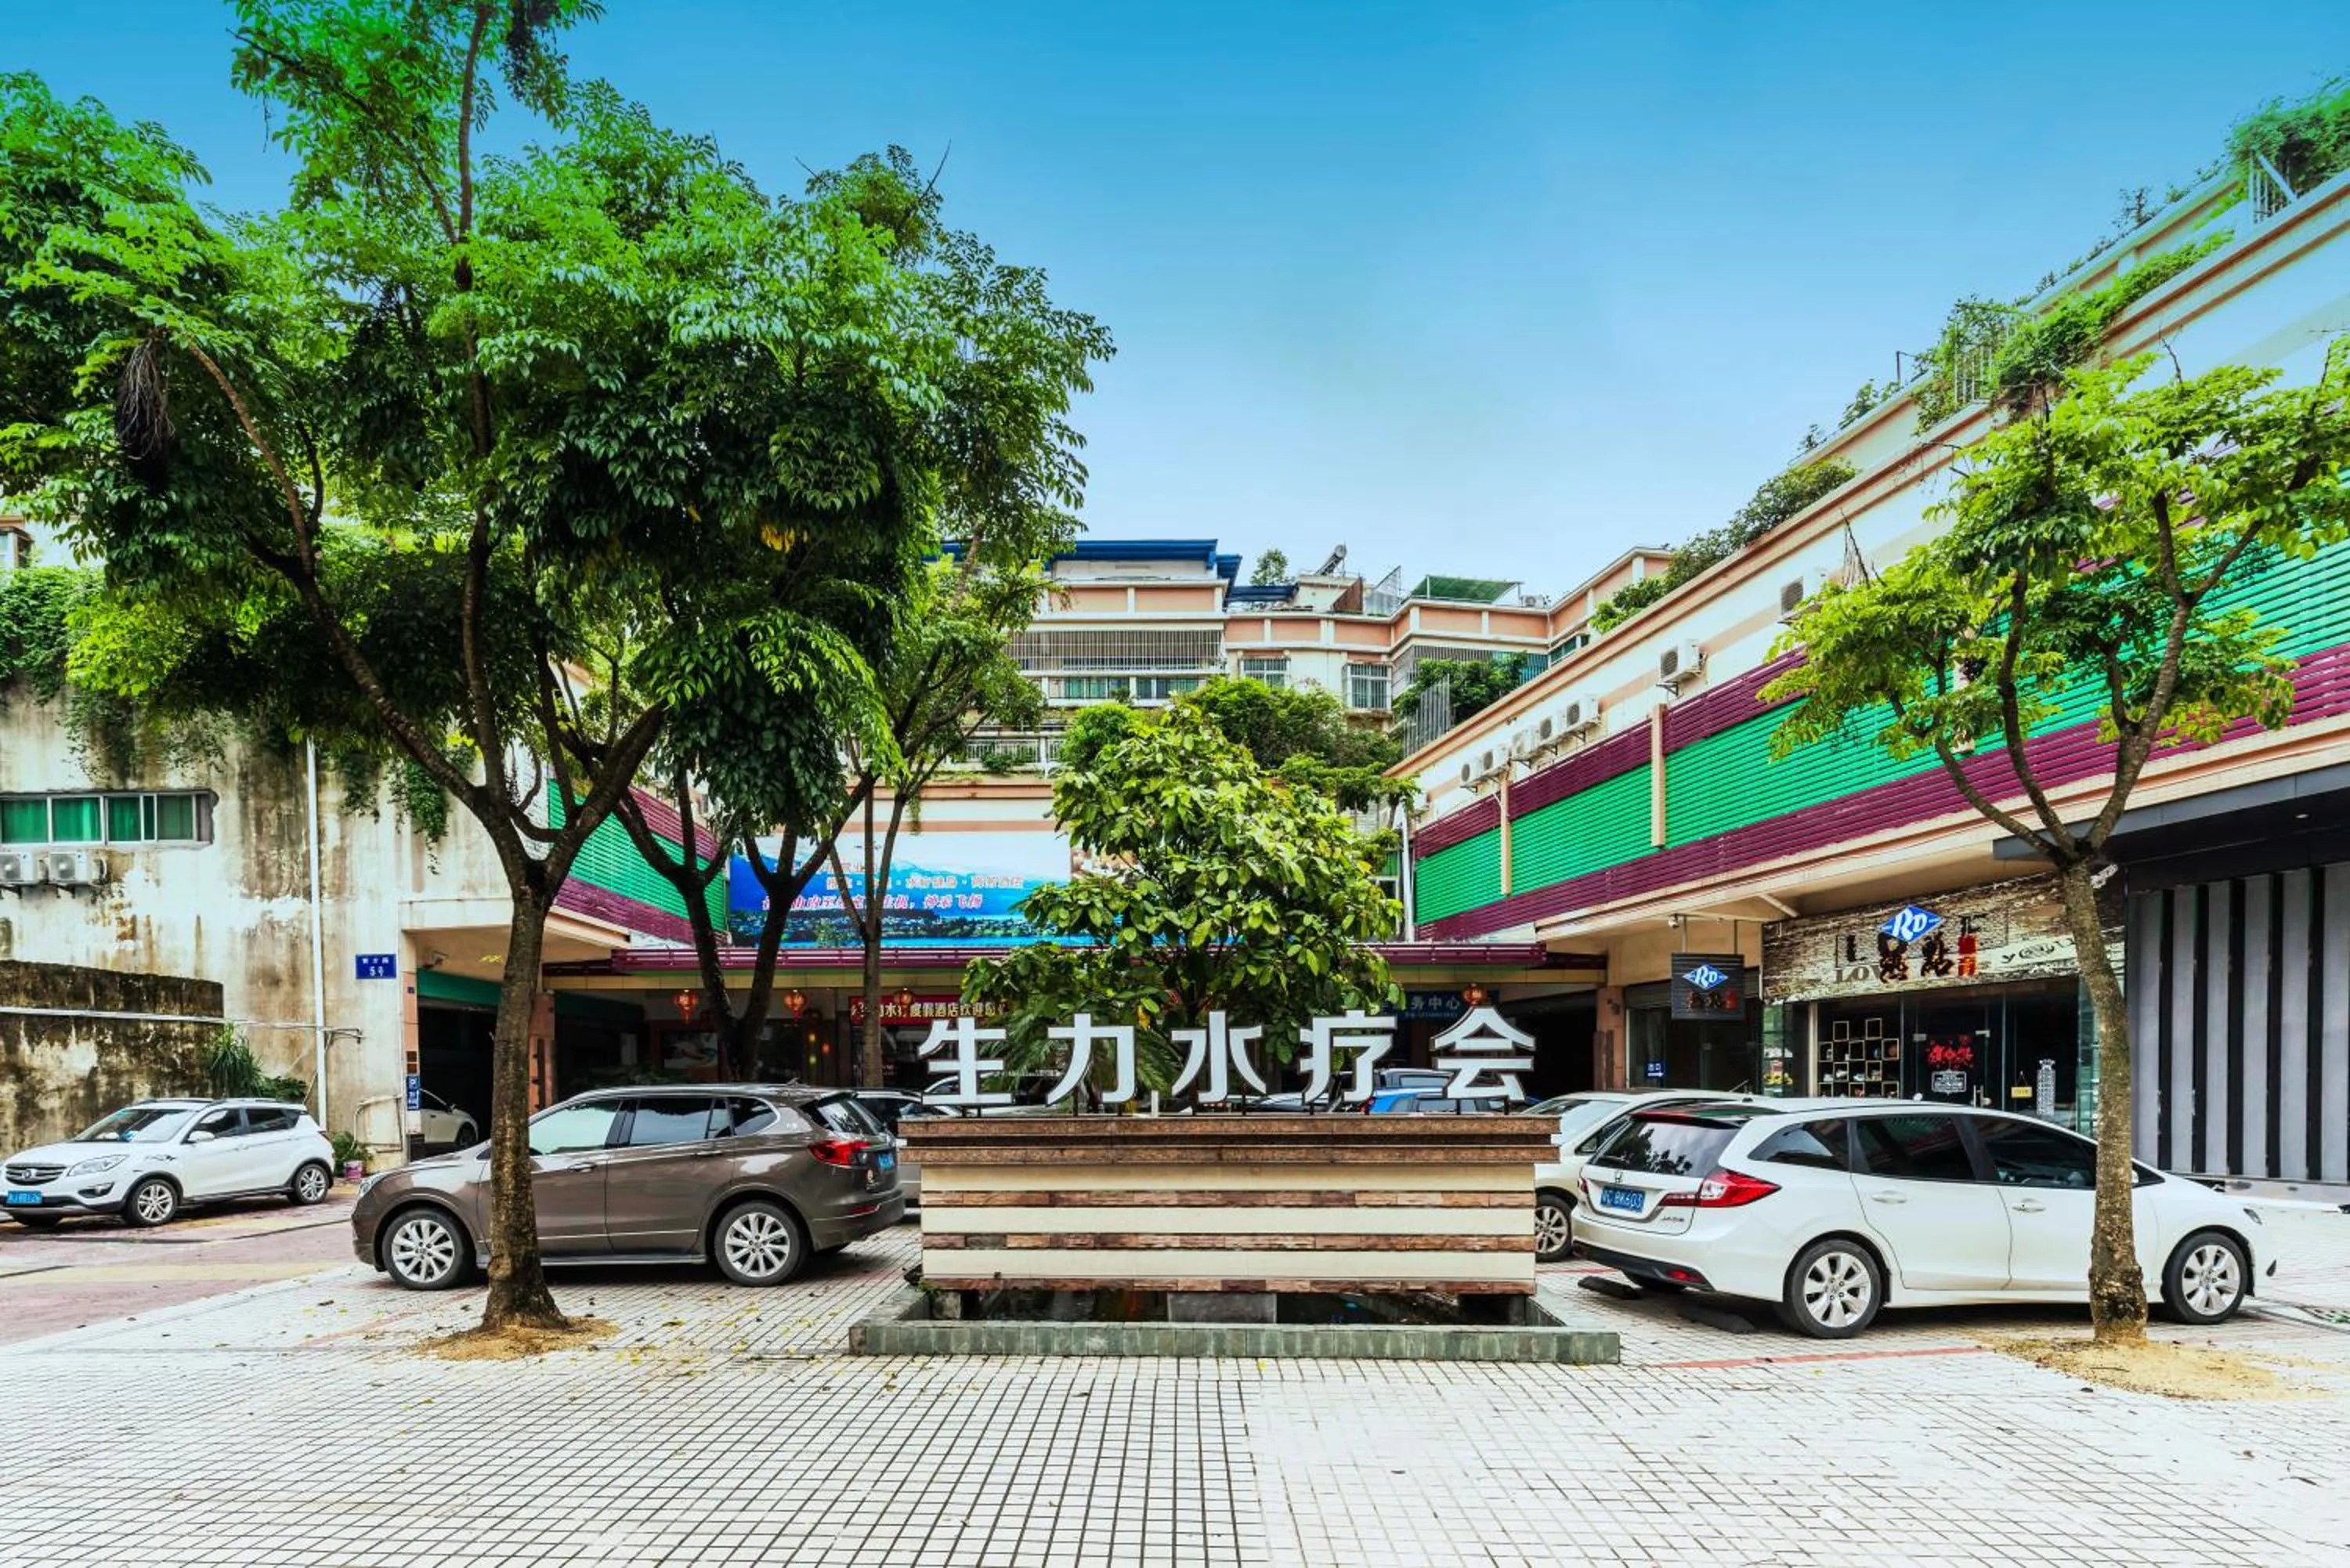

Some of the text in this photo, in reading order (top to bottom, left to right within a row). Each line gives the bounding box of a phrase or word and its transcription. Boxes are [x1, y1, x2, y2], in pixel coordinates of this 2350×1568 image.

[918, 1006, 1536, 1105] 生力水疗会
